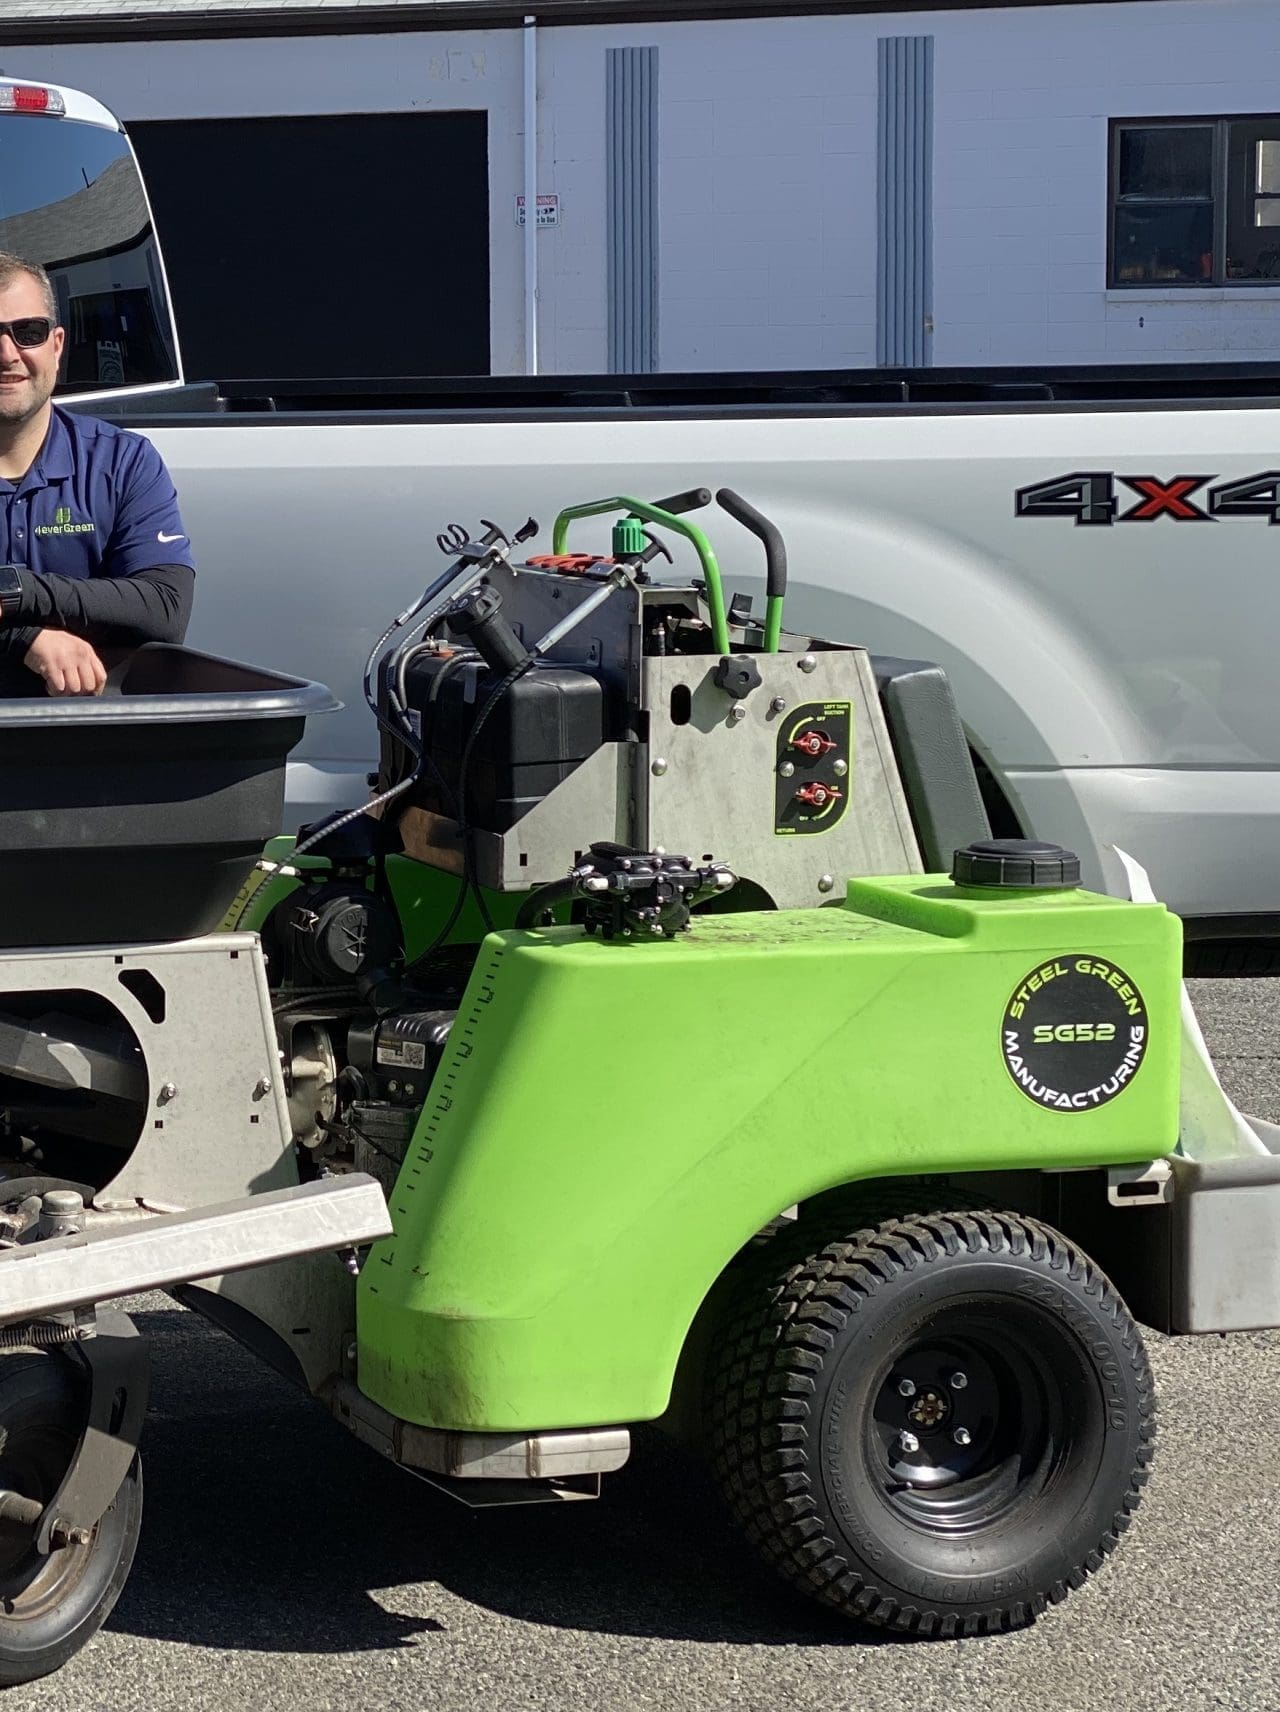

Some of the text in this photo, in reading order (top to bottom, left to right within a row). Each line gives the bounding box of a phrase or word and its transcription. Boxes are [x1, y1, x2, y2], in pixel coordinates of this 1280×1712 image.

[1010, 959, 1142, 1020] STEEL GREEN
[1033, 1023, 1116, 1043] SG52
[1004, 1025, 1145, 1107] MANUFACTURING
